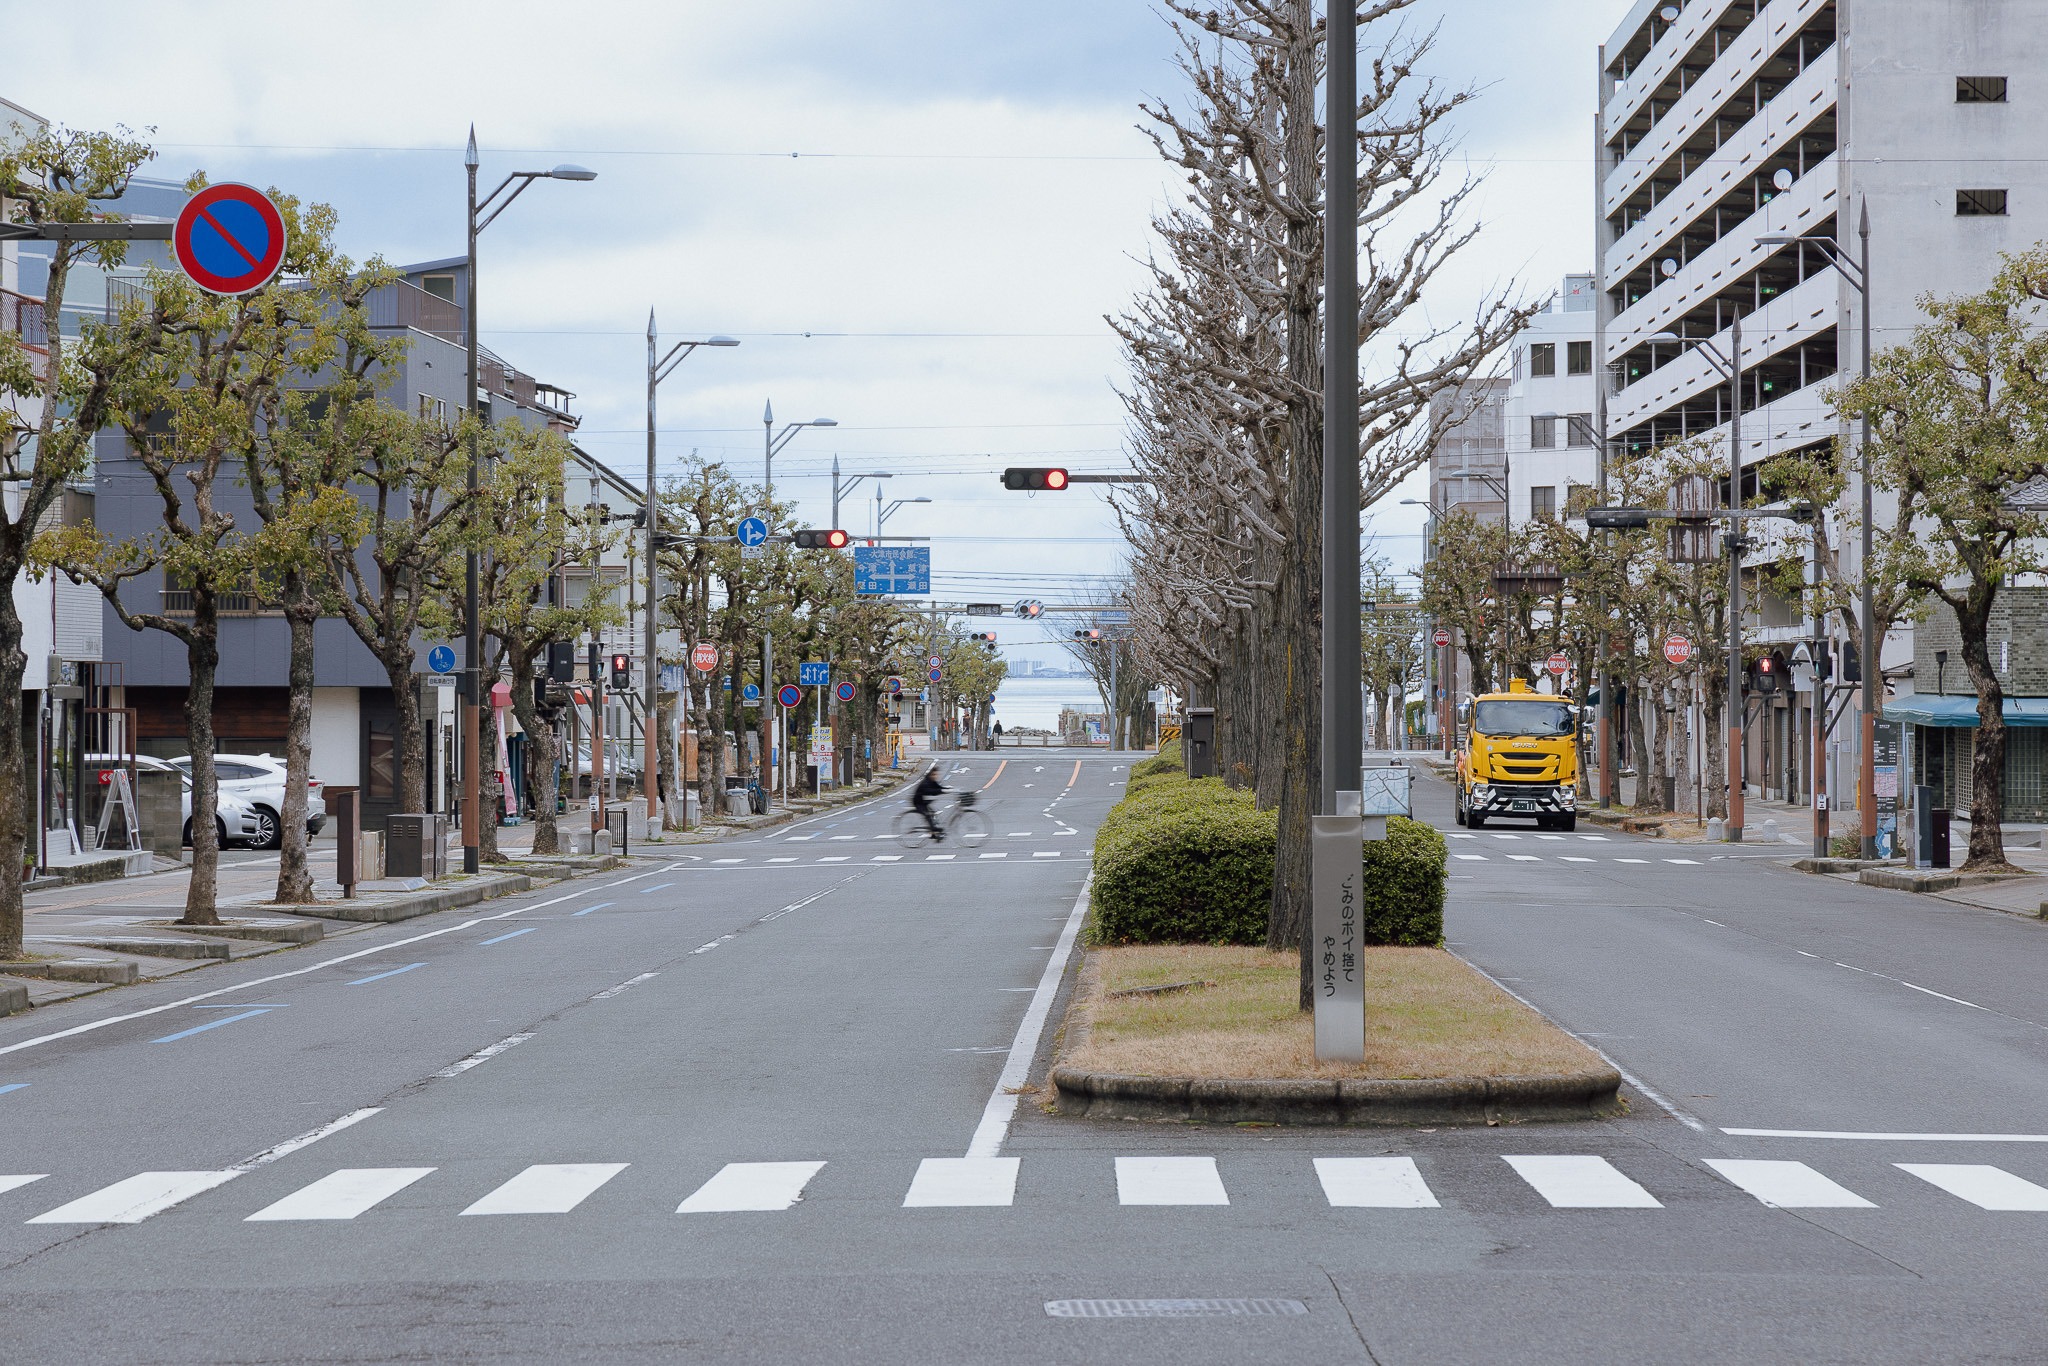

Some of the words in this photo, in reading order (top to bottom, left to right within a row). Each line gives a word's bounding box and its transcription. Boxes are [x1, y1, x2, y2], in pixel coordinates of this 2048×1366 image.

[870, 549, 914, 560] 大津市民会館
[906, 581, 928, 590] 瀬田
[1666, 645, 1689, 656] 消火栓
[694, 652, 717, 664] 消火栓
[1323, 935, 1336, 997] やめよう
